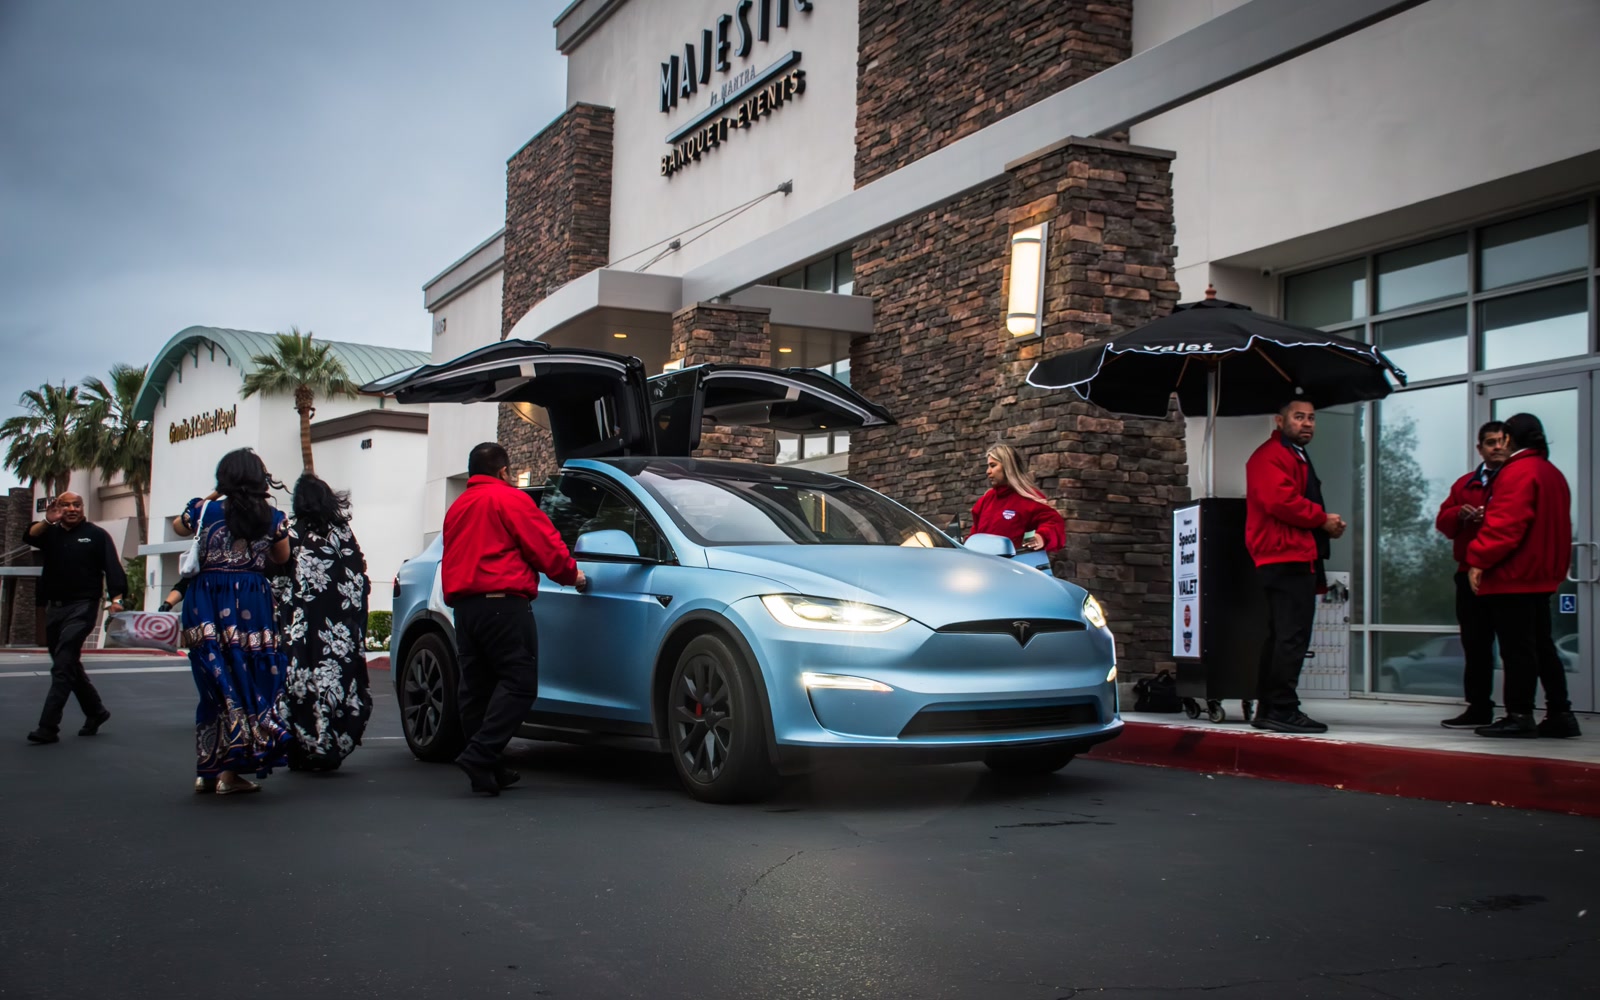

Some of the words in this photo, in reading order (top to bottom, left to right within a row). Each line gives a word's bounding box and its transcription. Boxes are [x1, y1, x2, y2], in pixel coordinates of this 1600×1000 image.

[661, 117, 728, 177] BANQUET
[737, 69, 806, 129] EVENTS
[217, 404, 236, 434] Depot
[1179, 527, 1197, 550] Special
[1181, 550, 1194, 565] Event
[1178, 579, 1198, 596] VALET
